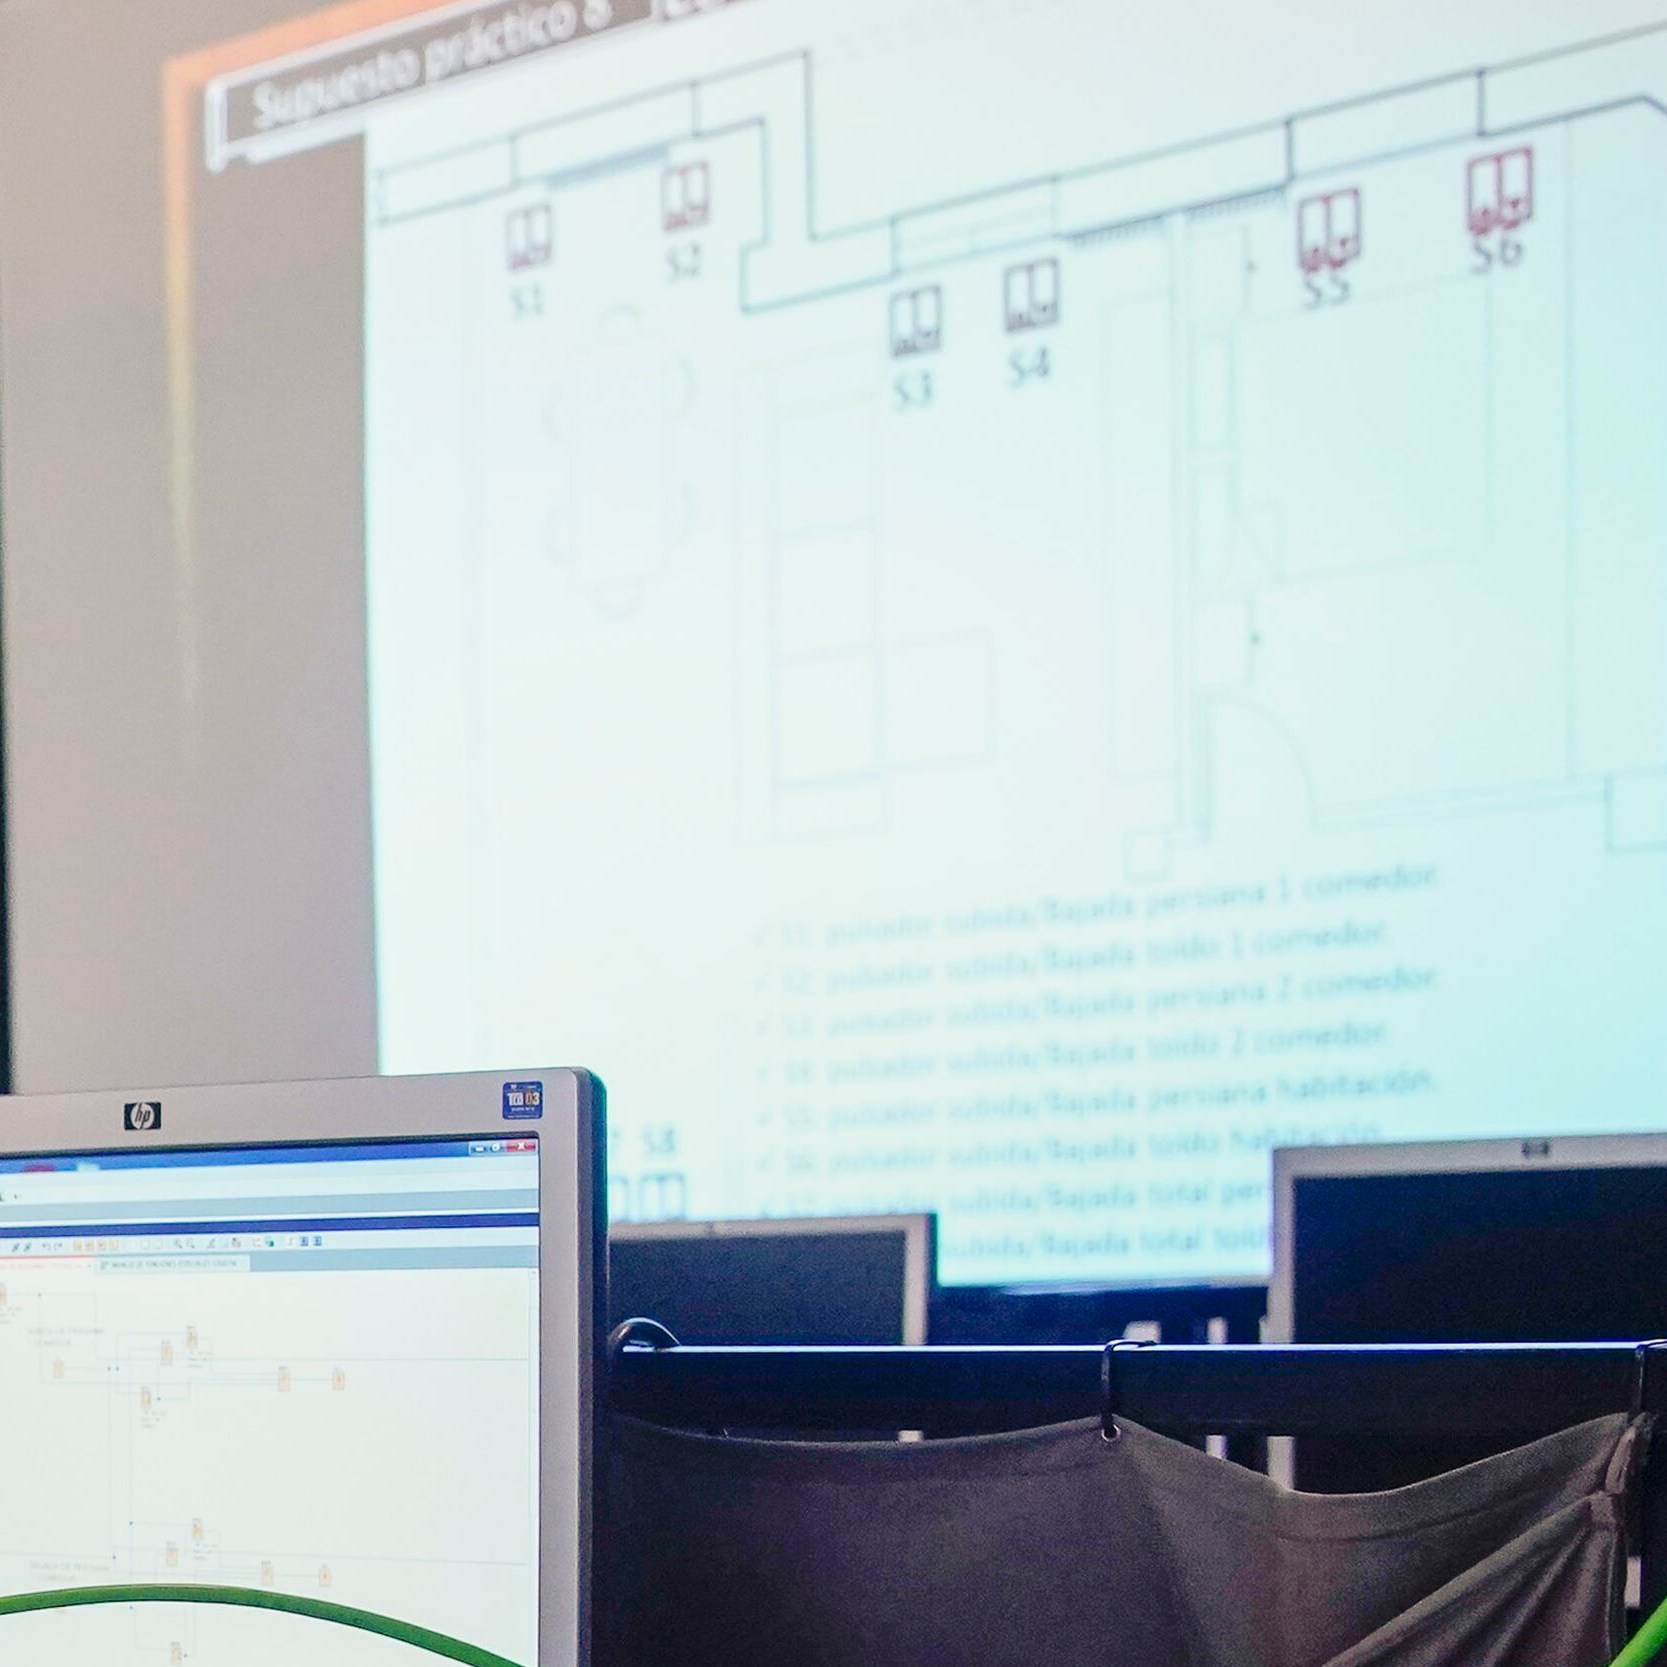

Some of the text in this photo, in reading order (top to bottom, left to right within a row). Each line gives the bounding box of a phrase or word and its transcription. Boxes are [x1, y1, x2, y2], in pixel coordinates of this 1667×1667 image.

[254, 46, 421, 131] Supuesto
[1471, 238, 1524, 275] S6
[1303, 274, 1351, 309] S5
[1008, 345, 1052, 391] S4
[893, 370, 934, 412] S3
[1221, 1185, 1270, 1210] per
